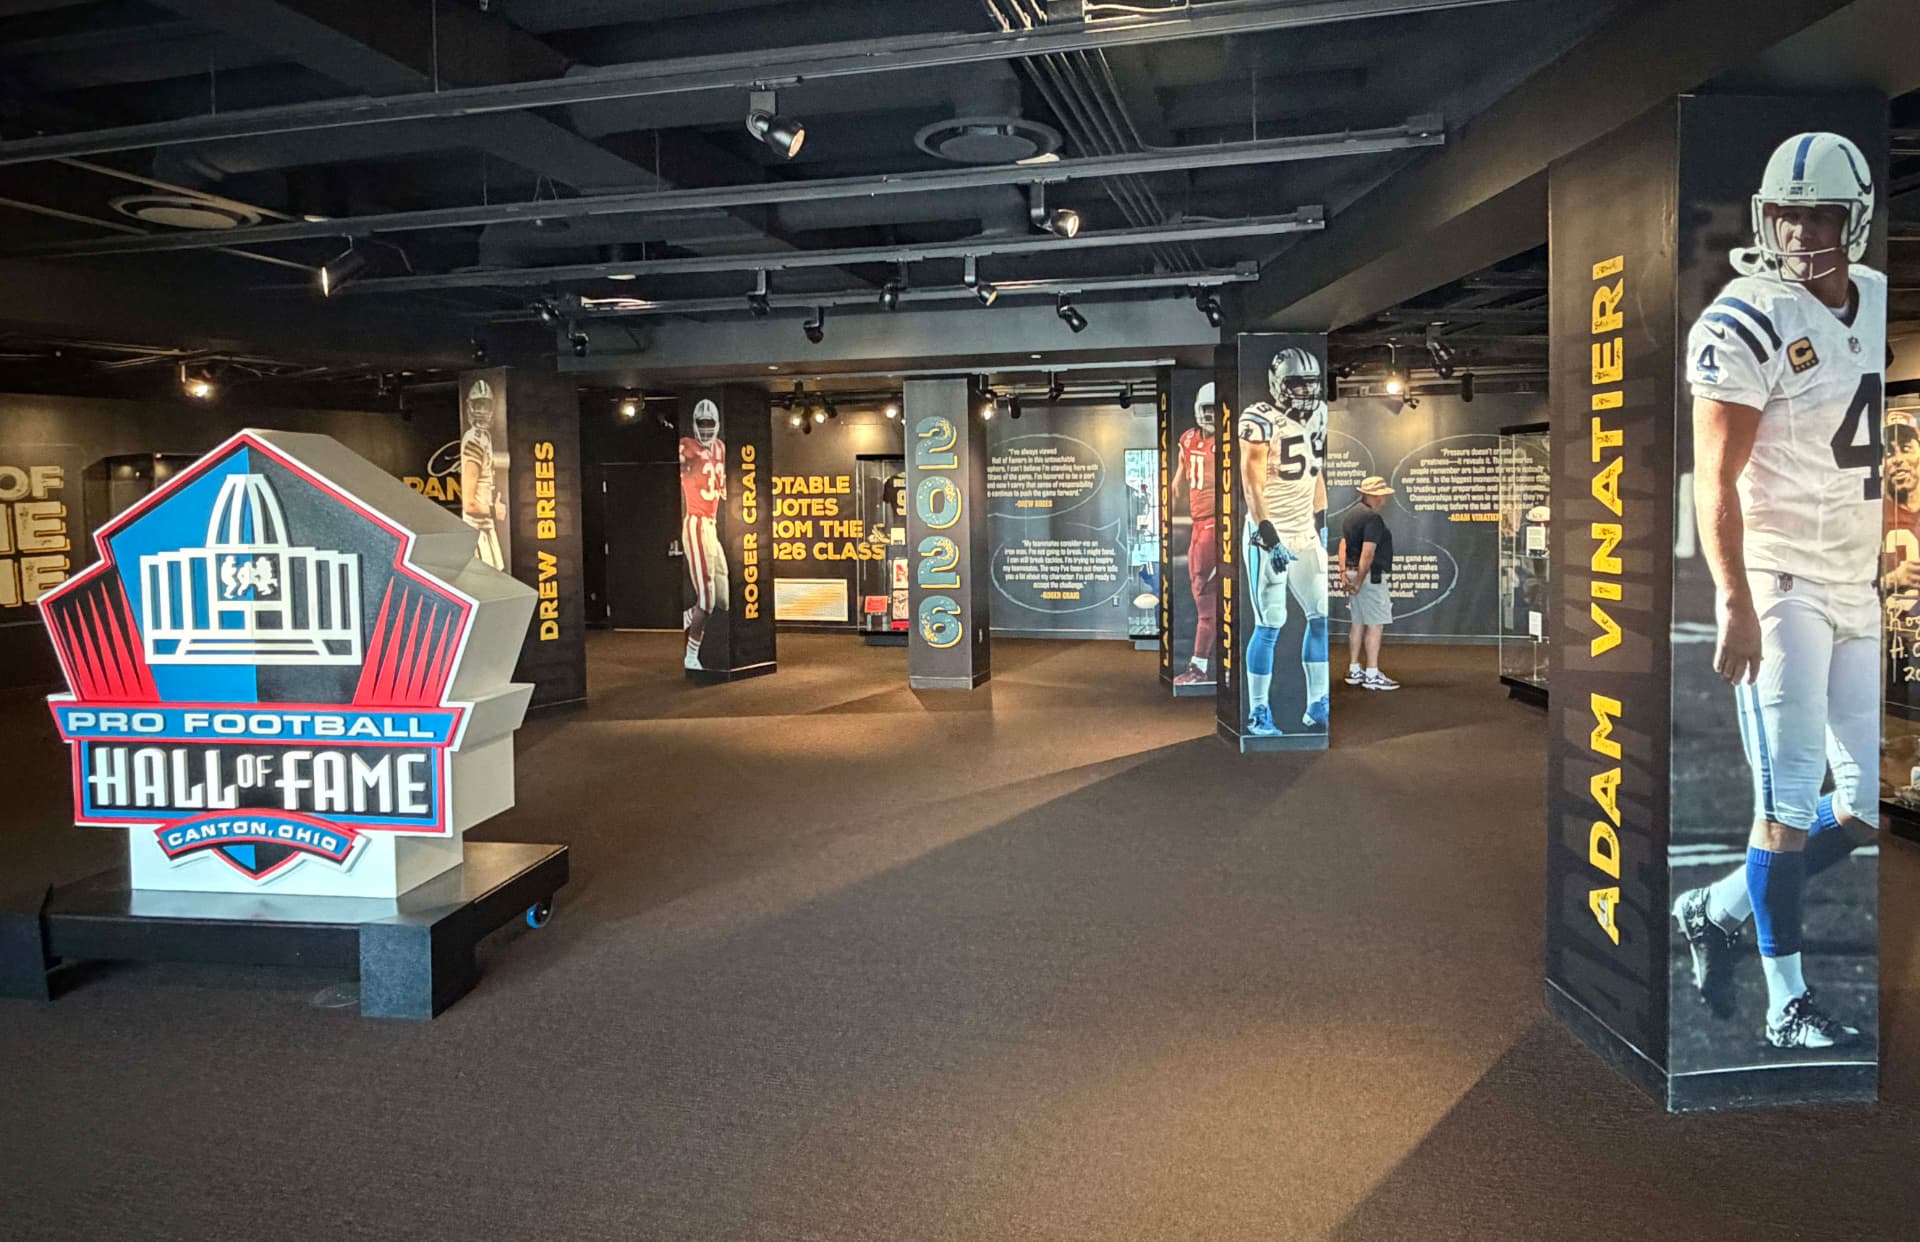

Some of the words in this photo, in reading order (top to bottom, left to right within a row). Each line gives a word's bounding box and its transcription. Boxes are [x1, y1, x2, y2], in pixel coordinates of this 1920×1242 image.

[1697, 344, 1719, 371] 4
[1190, 454, 1204, 490] 11
[1591, 254, 1624, 657] VINATIERI
[1830, 372, 1884, 501] 4
[534, 441, 557, 540] BREES
[741, 444, 758, 525] CRAIG
[772, 476, 850, 495] OTABLE
[1222, 400, 1232, 565] KUECHLY
[813, 542, 886, 560] CLASS
[820, 520, 864, 538] THE
[914, 415, 963, 649] 2026
[537, 550, 560, 641] DREW
[744, 532, 760, 620] ROGER
[1223, 577, 1232, 669] LUKE
[67, 711, 165, 734] PRO
[183, 712, 435, 739] FOOTBALL
[89, 747, 239, 810] HALL
[236, 754, 273, 788] OF
[274, 750, 429, 814] FAME
[1589, 692, 1623, 946] ADAM
[167, 821, 276, 847] CANTON,
[278, 824, 338, 852] OHIO
